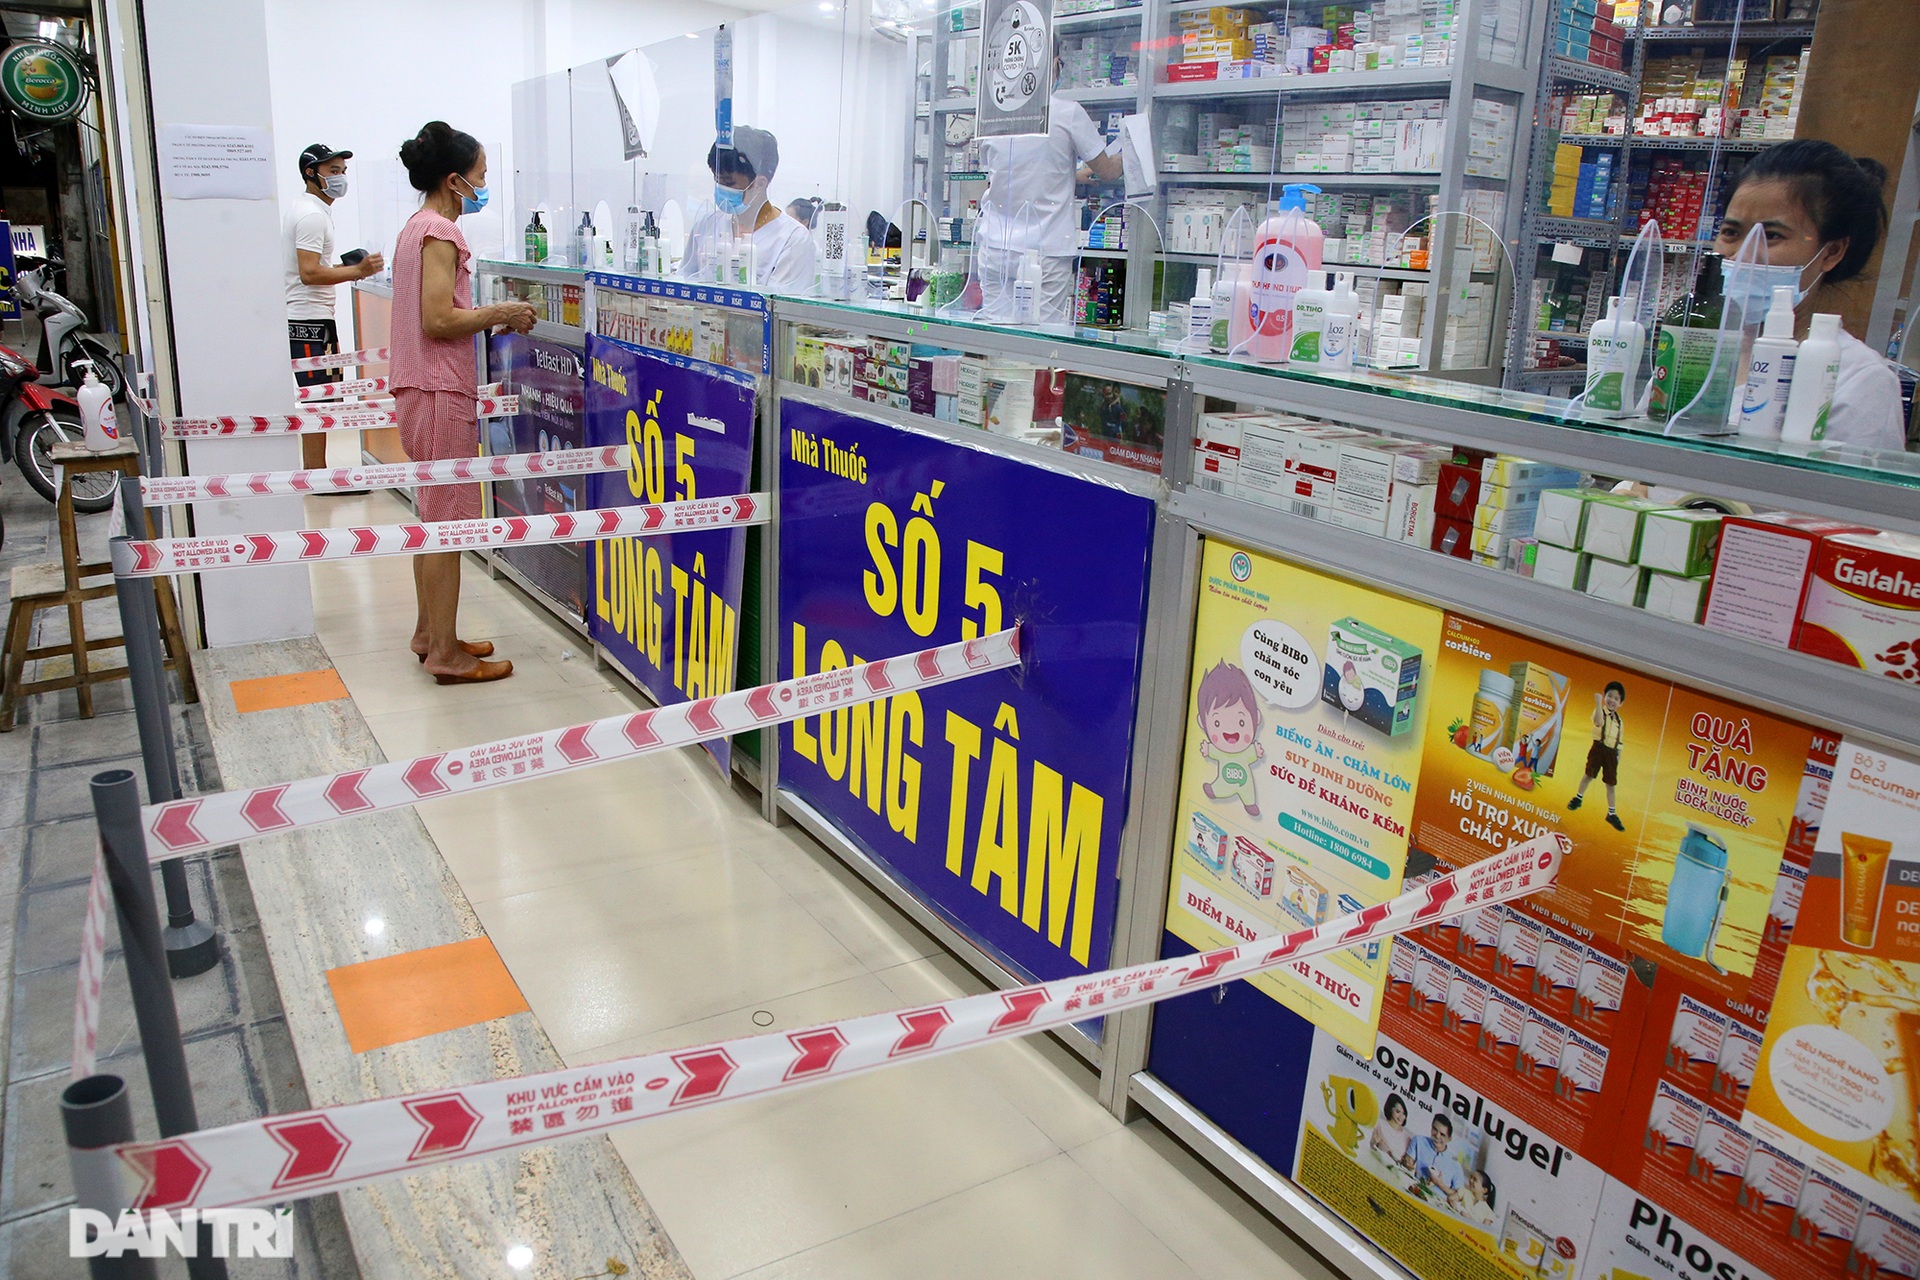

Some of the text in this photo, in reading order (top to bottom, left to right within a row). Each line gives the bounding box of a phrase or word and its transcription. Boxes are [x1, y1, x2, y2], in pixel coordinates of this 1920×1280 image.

[1008, 40, 1022, 56] 5K
[25, 76, 56, 84] Berocca
[21, 100, 48, 114] MINH
[1671, 244, 1685, 252] 185
[1296, 304, 1323, 313] DR.TINO
[535, 348, 572, 376] Telfast HD
[625, 389, 696, 503] SỐ 5
[791, 428, 869, 485] Nhà Thuốc
[1110, 446, 1162, 467] GIẢM ĐAU NHANH
[1227, 447, 1236, 456] 400
[1322, 470, 1333, 478] 400
[186, 548, 213, 556] ALLOWED
[213, 546, 230, 554] AREA
[216, 539, 229, 547] VÀO
[863, 479, 1004, 641] SỐ 5
[670, 551, 736, 704] TÂM
[1253, 629, 1309, 665] Cùng BIBO
[1445, 639, 1492, 661] corbière
[1253, 650, 1301, 681] chăm sóc
[1253, 668, 1293, 696] con yêu
[1317, 723, 1337, 740] Dành
[1337, 733, 1352, 745] cho
[1690, 710, 1753, 755] QUÀ
[1276, 725, 1313, 750] BIẾNG
[1314, 739, 1334, 759] ĂN
[1343, 755, 1381, 781] CHẬM
[1383, 772, 1411, 794] LỚN
[1687, 743, 1768, 794] TẶNG
[1853, 751, 1887, 772] Bộ 3
[1226, 768, 1245, 781] BIBO
[1285, 750, 1393, 808] SUY DINH DƯỠNG
[793, 621, 1104, 969] LONG TÂM
[1270, 764, 1406, 838] SỨC ĐỀ KHÁNG KÉM
[1450, 787, 1509, 829] HỖ TRỢ
[1467, 778, 1473, 788] 2
[1473, 780, 1493, 796] VIÊN
[1494, 790, 1516, 806] NHAI
[1536, 807, 1562, 824] NGÀY
[1679, 777, 1748, 813] BÌNH NƯỚC
[1301, 808, 1370, 849] www.bibo.com.vn
[1459, 816, 1504, 848] CHẮC
[1293, 822, 1373, 870] Hotline: 1800 6984
[1520, 847, 1535, 861] VÀO
[1469, 861, 1534, 891] NOT ALLOWED AREA
[1187, 892, 1223, 924] ĐIỂM
[1225, 914, 1258, 942] BÁN
[1505, 907, 1543, 933] Pharmaton
[1519, 928, 1540, 942] Vitality
[1545, 926, 1583, 953] Pharmaton
[1418, 947, 1451, 972] Pharmaton
[1430, 966, 1449, 980] Vitality
[1586, 948, 1627, 975] Pharmaton
[1314, 970, 1361, 1008] THỨC
[1453, 966, 1488, 992] Pharmaton
[1601, 969, 1624, 985] Vitality
[1490, 986, 1526, 1013] Pharmaton
[1681, 995, 1726, 1027] Pharmaton
[1528, 1007, 1566, 1035] Pharmaton
[1698, 1018, 1723, 1037] Vitality
[1568, 1029, 1608, 1059] Pharmaton
[1582, 1051, 1604, 1068] Vitality
[1795, 1038, 1880, 1085] SIÊU NGHỆ NANO
[506, 1089, 536, 1106] KHU
[573, 1075, 603, 1094] CẤM
[608, 1071, 635, 1087] VÀO
[1336, 1044, 1434, 1115] Giảm axit dạ dày hiệu quả
[1840, 1075, 1864, 1092] 7500
[507, 1086, 634, 1117] NOT ALLOWED AREA
[1376, 1045, 1565, 1178] osphalugel
[1659, 1081, 1703, 1113] Pharmaton
[1706, 1107, 1752, 1141] Pharmaton
[1723, 1131, 1749, 1151] Vitality
[1829, 1191, 1859, 1213] Vitality
[1510, 1209, 1554, 1246] Phosphalugel
[1625, 1234, 1675, 1274] Giảm axit
